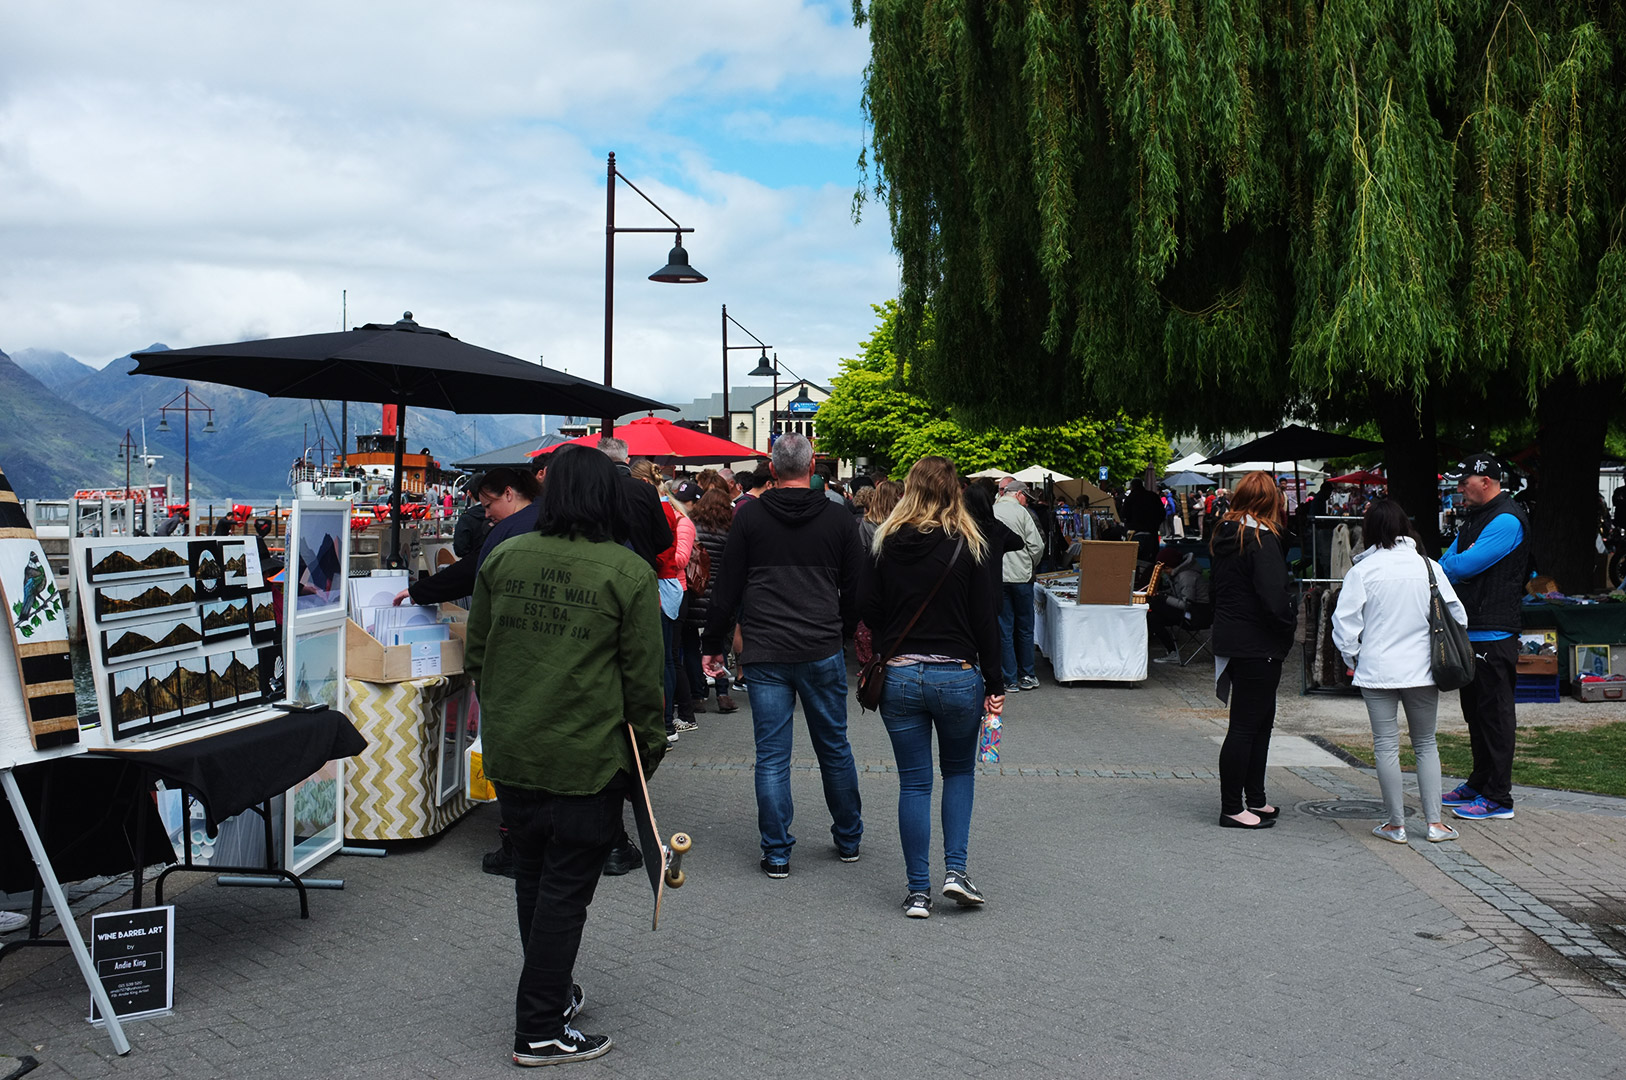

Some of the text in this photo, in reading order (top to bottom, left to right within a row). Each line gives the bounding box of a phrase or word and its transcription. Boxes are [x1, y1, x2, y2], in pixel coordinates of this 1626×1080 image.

[541, 567, 572, 585] VANS
[505, 579, 598, 606] OFF THE WALL
[524, 602, 571, 622] EST. CA.
[499, 615, 591, 640] SINCE SIXTY SIX
[97, 926, 164, 941] WINE BARREL ART
[114, 959, 147, 970] Andie King
